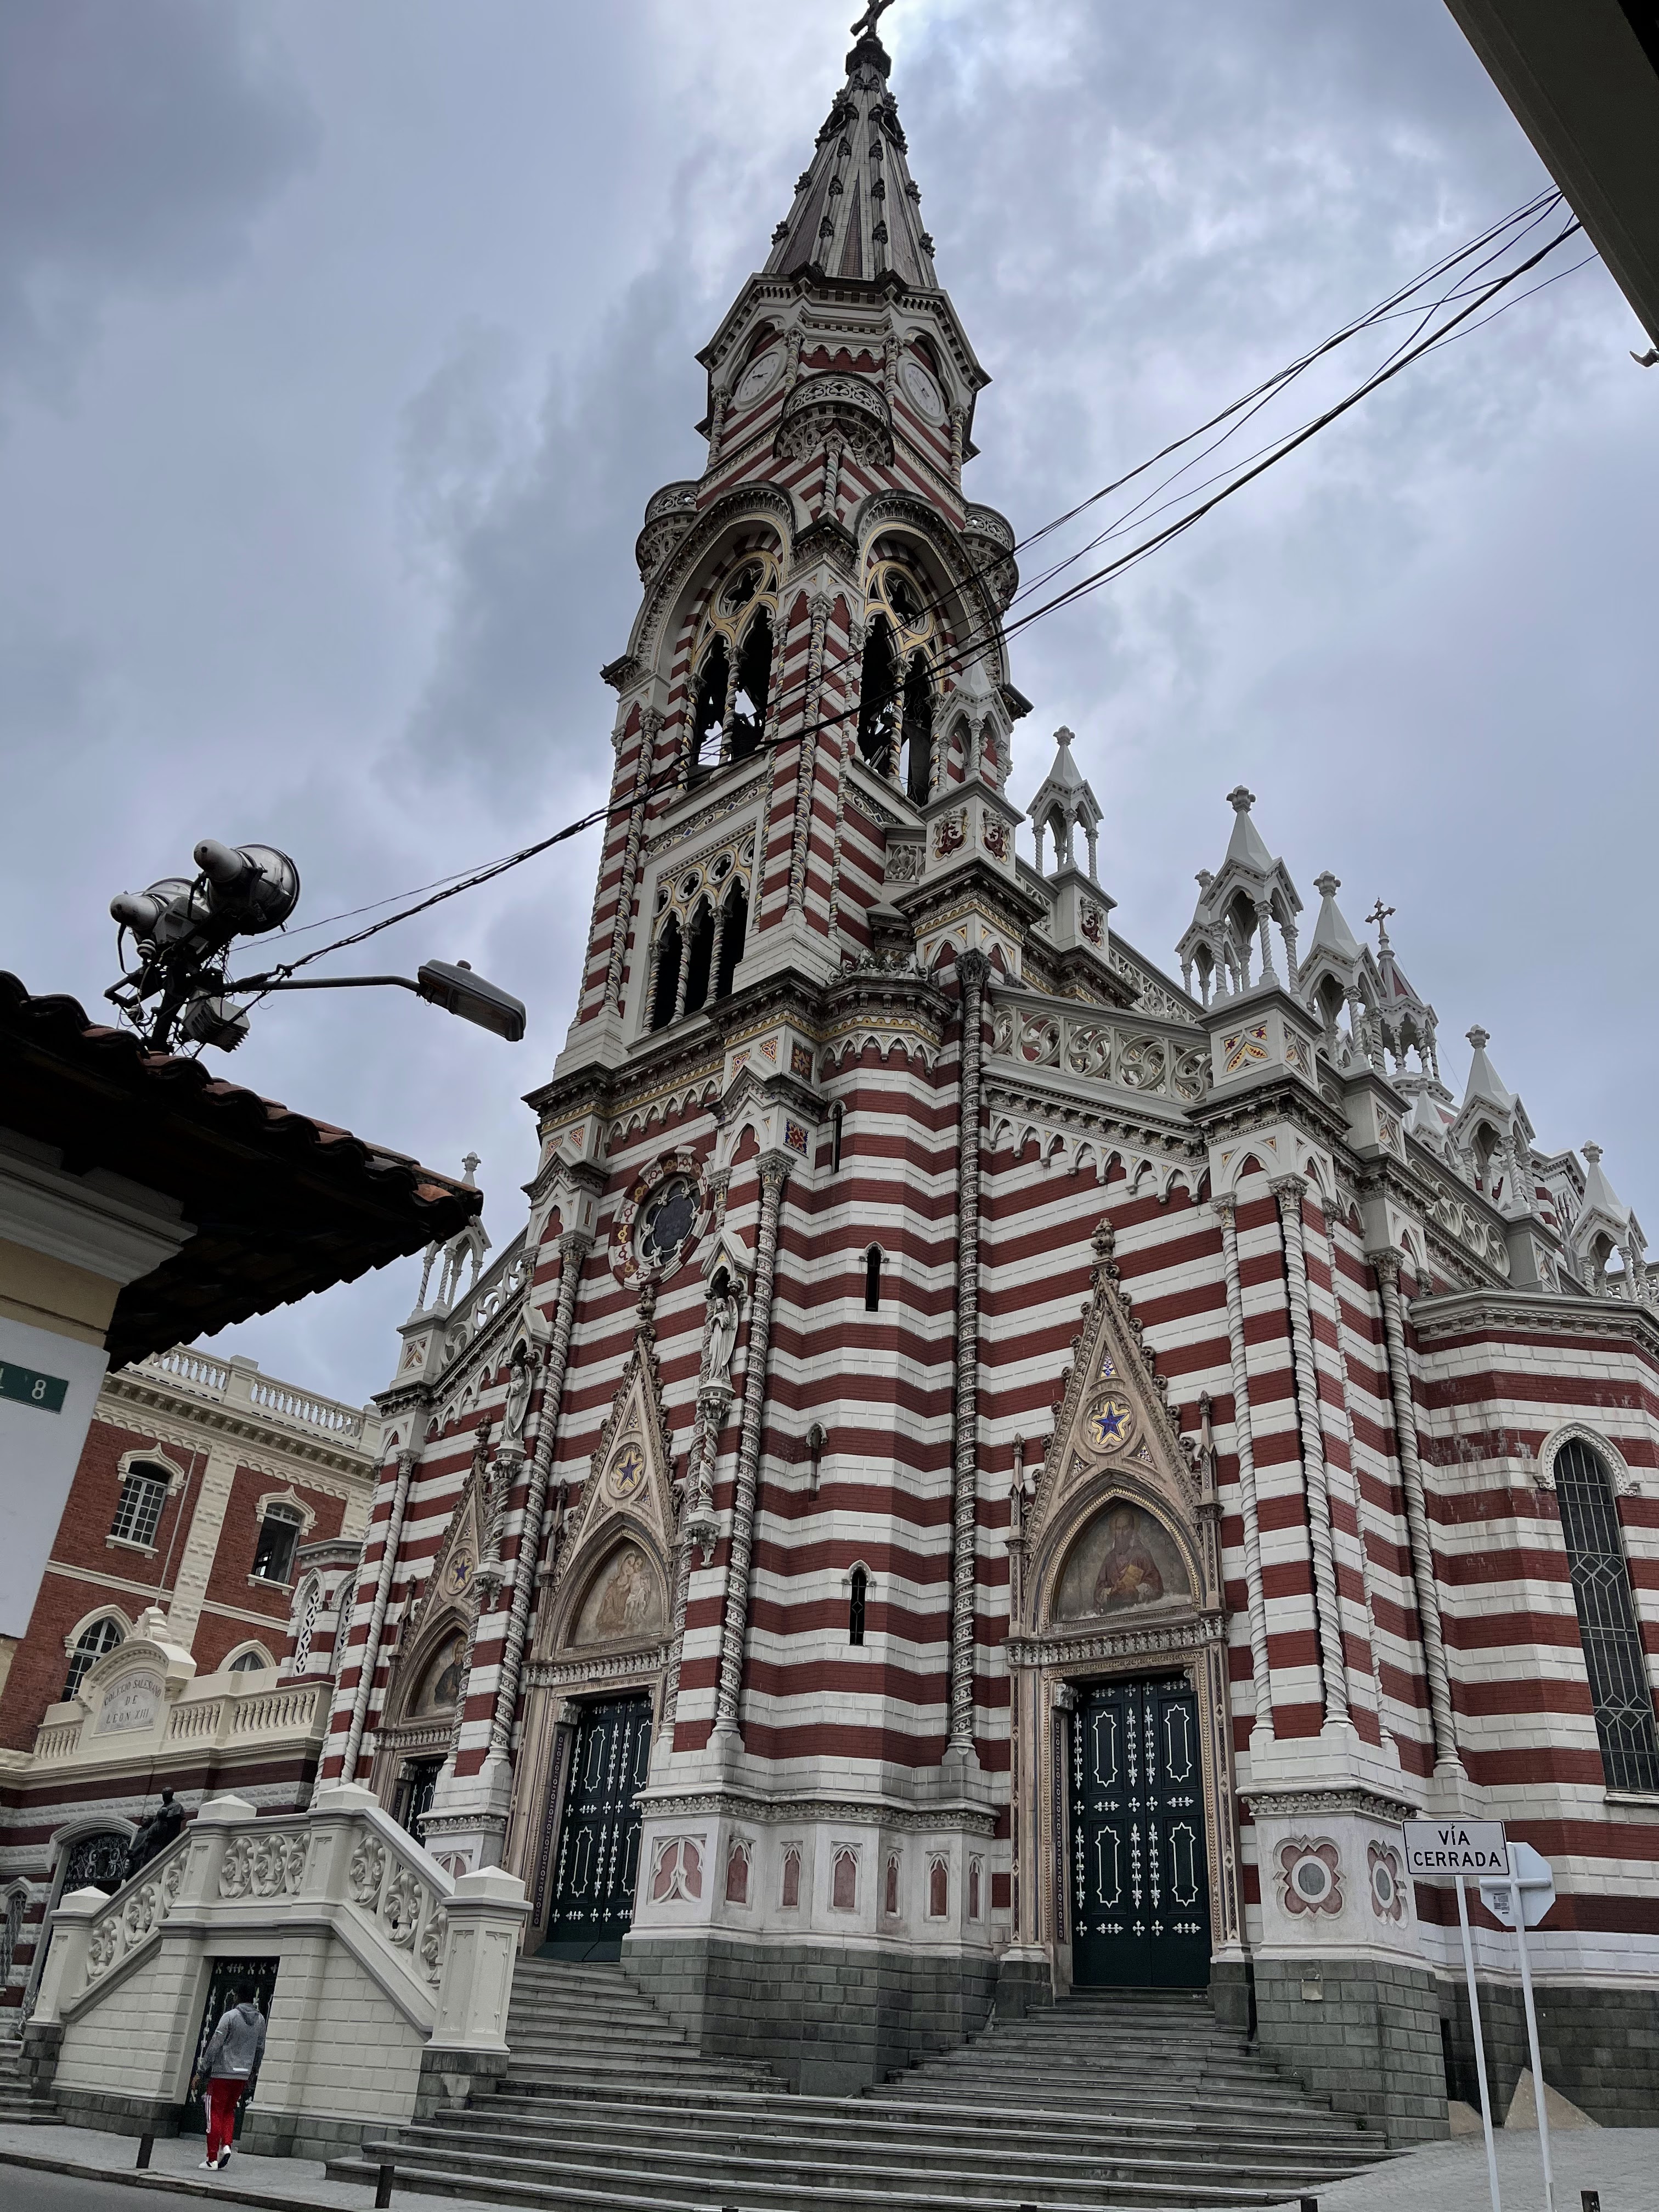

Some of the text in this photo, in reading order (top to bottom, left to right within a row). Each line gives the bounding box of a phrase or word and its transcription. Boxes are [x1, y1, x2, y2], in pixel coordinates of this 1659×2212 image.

[31, 1379, 47, 1400] 8
[104, 1679, 162, 1706] COLEGIO SALESIANO
[125, 1695, 138, 1706] DE
[106, 1708, 150, 1724] LEON XIII
[1437, 1825, 1471, 1846] VÍA
[1413, 1851, 1502, 1867] CERRADA
